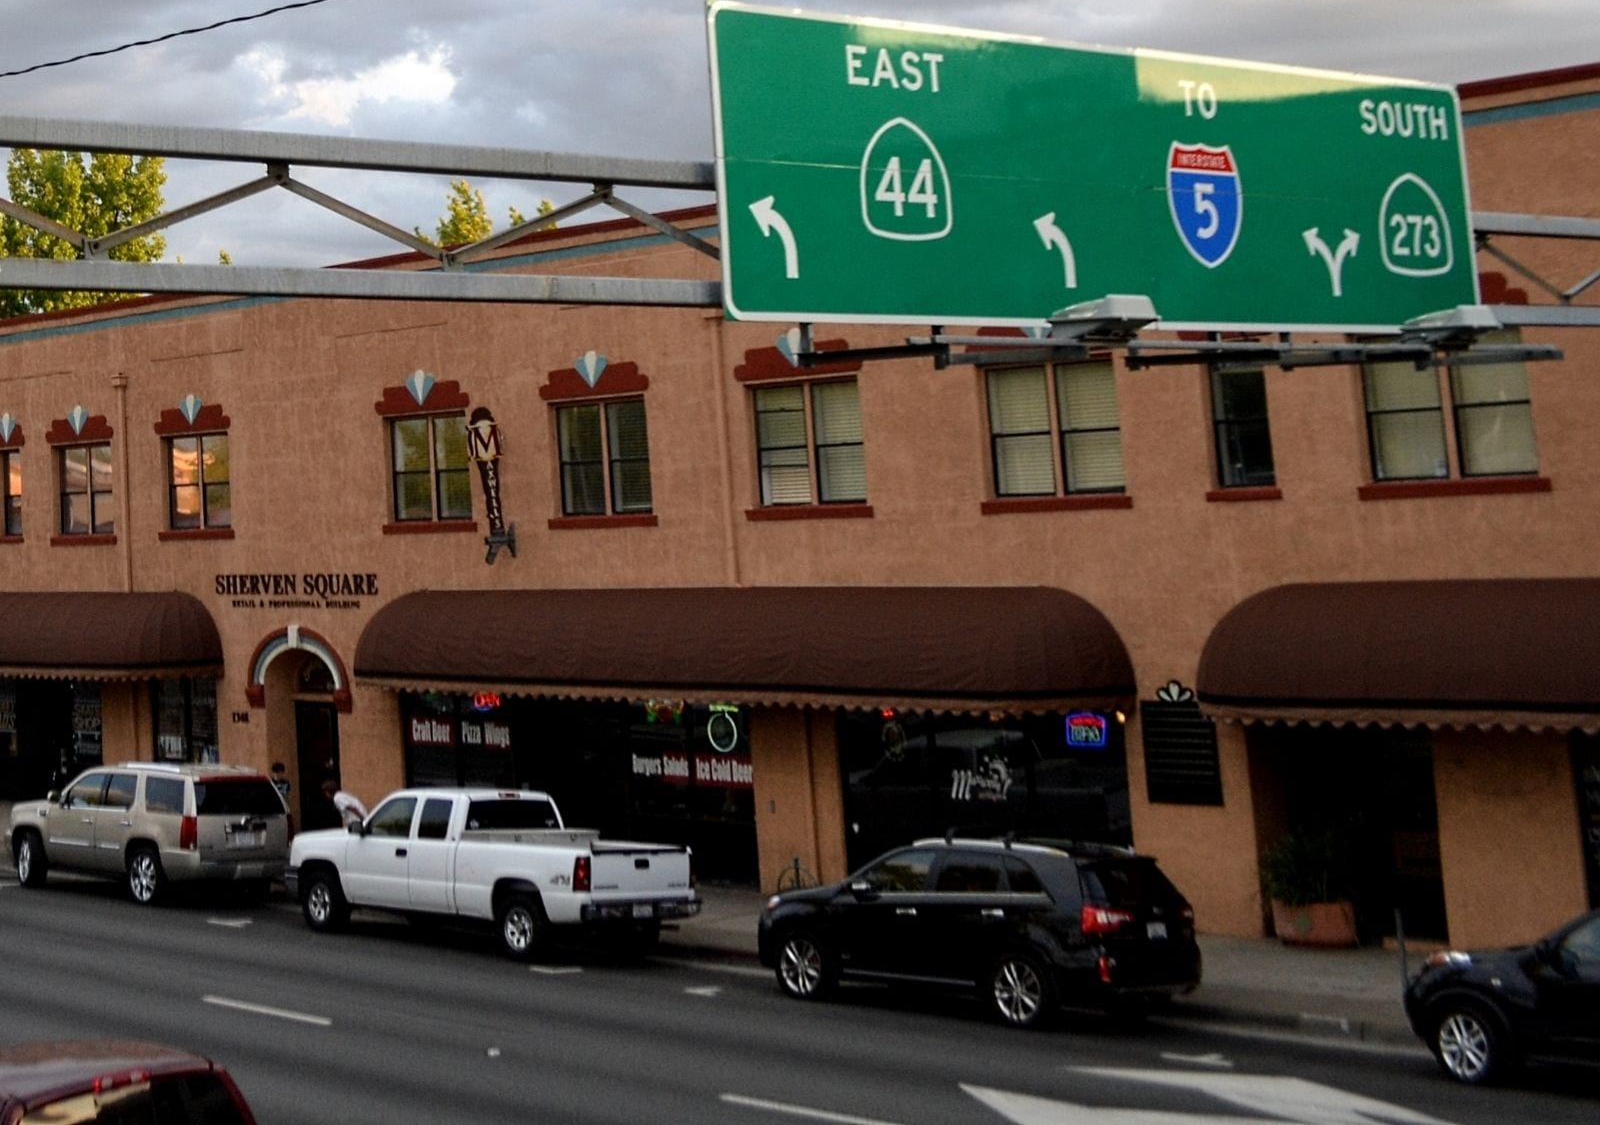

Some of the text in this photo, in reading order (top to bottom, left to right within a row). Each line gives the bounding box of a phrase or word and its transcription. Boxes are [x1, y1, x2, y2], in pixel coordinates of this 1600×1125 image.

[846, 45, 944, 92] EAST
[1177, 80, 1217, 119] TO
[1359, 99, 1448, 141] SOUTH
[874, 156, 938, 218] 44
[1192, 182, 1218, 240] 5
[1390, 213, 1442, 259] 273
[215, 573, 379, 598] SHERVEN SQUARE
[268, 599, 321, 609] PROFESSIONAL
[325, 599, 361, 610] BUILDING
[473, 691, 502, 709] OPEN
[412, 718, 451, 743] Craft Beer
[461, 721, 511, 748] Pizza Wings
[631, 752, 689, 777] Burgers Salads
[695, 757, 753, 783] Ice Cold Beer
